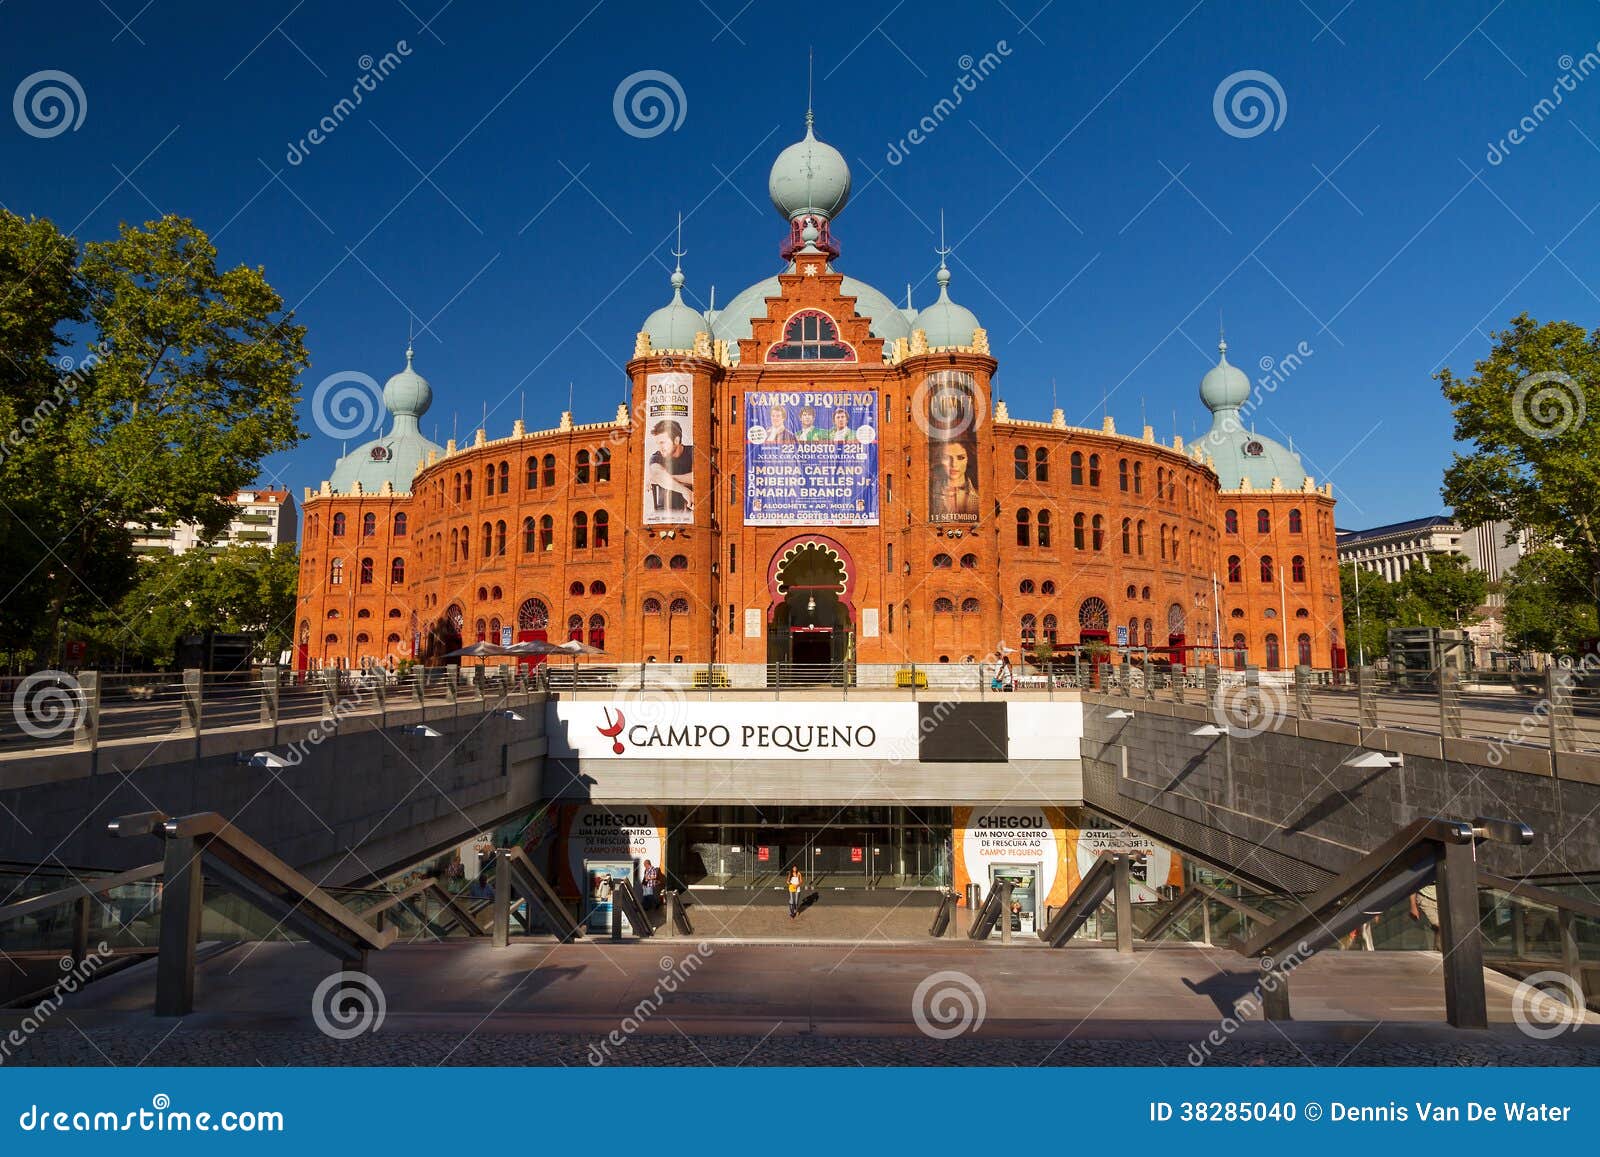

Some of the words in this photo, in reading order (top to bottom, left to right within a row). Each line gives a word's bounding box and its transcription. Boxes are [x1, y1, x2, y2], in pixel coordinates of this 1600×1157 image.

[749, 393, 800, 407] CAMPO
[804, 393, 873, 408] PEQUENO
[782, 444, 795, 454] 22
[797, 444, 835, 454] AGOSTO
[844, 444, 864, 454] 22H
[756, 466, 802, 475] MOURA
[804, 466, 863, 475] CAETANO
[756, 477, 806, 486] RIBEIRO
[809, 477, 854, 486] TELLES
[756, 488, 797, 497] MARIA
[799, 488, 853, 497] BRANCO
[628, 725, 731, 747] CAMPO
[741, 725, 876, 752] PEQUENO
[583, 814, 648, 826] CHEGOU
[978, 816, 1043, 828] CHEGOU
